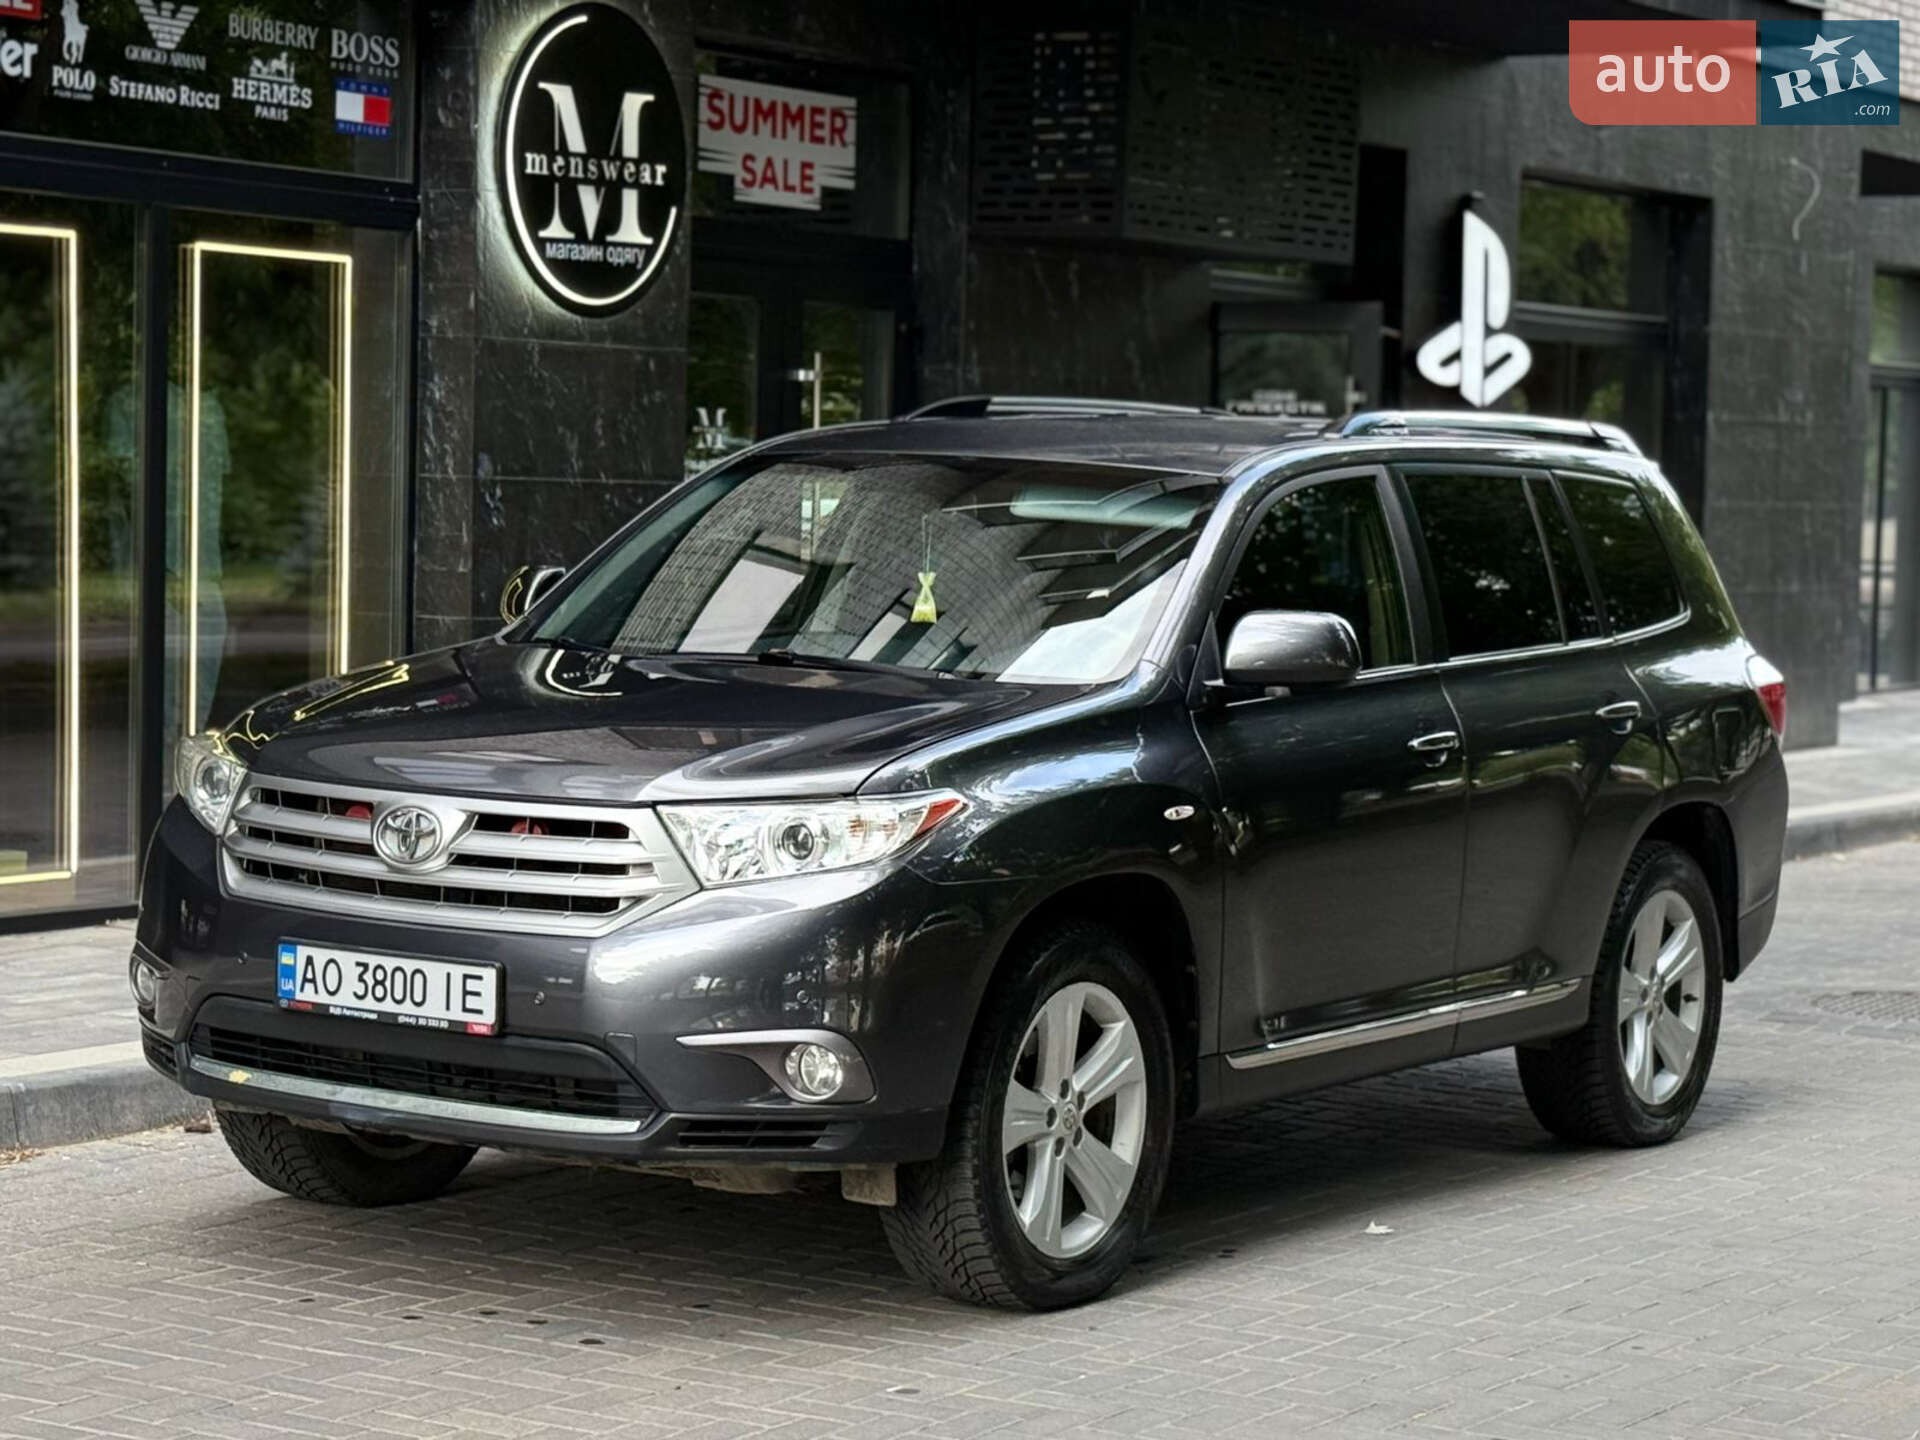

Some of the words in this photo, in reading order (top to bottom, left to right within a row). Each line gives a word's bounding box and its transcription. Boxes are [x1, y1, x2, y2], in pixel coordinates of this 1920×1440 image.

[228, 13, 320, 51] BURBERRY
[330, 28, 400, 68] BOSS
[51, 65, 96, 92] POLO
[109, 75, 177, 103] STEFANO
[179, 84, 221, 110] RICCI
[254, 104, 289, 122] PARIS
[706, 88, 848, 147] SUMMER
[524, 151, 667, 186] menswear
[741, 153, 815, 194] SALE
[545, 241, 604, 262] магазин
[606, 245, 646, 270] одягу
[281, 978, 295, 991] UA
[300, 955, 343, 996] AO
[353, 961, 427, 1007] 3800
[445, 972, 484, 1015] IE
